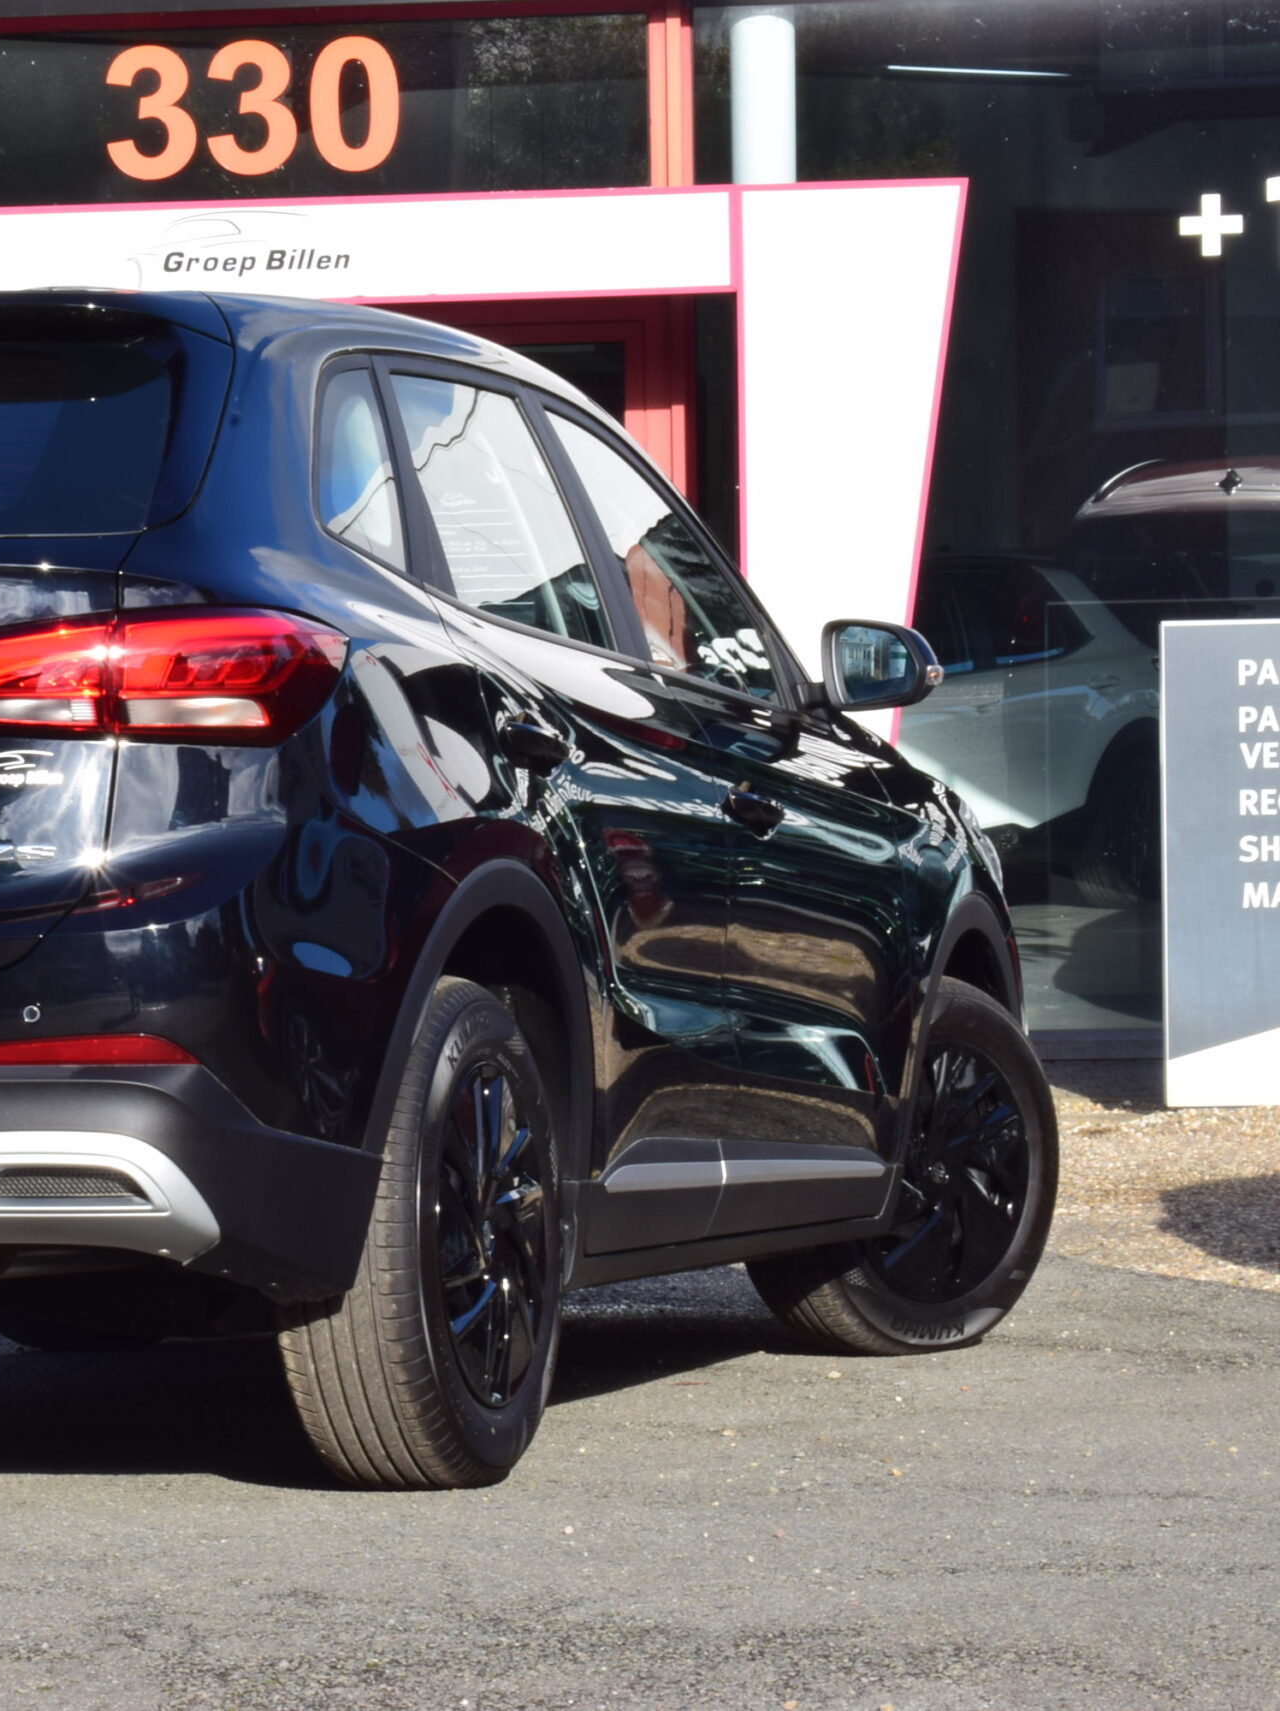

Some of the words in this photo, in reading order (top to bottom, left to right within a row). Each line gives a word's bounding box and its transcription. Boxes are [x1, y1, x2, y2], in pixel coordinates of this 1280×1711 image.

[105, 35, 400, 181] 330
[163, 251, 256, 277] Groep
[265, 249, 351, 270] Billen
[1239, 788, 1280, 816] RE
[889, 1317, 966, 1341] KUMHO
